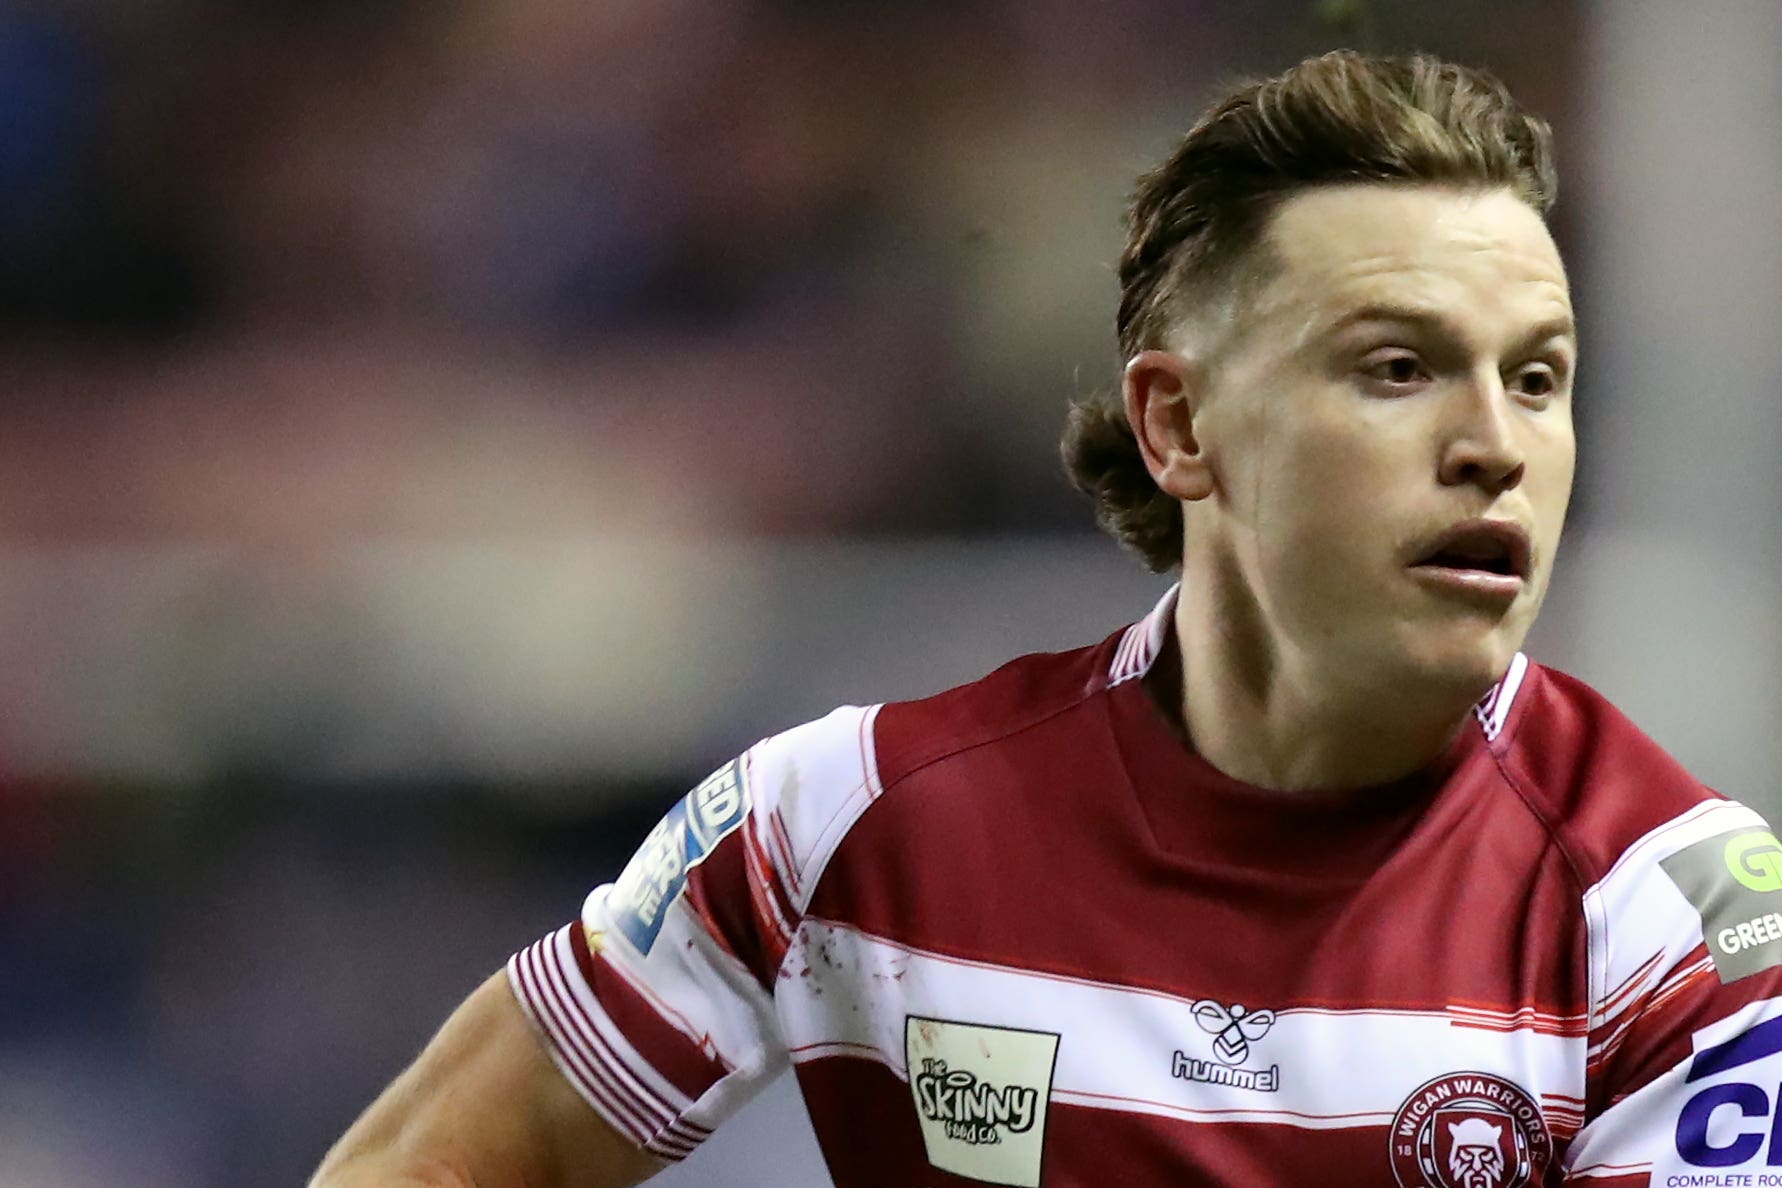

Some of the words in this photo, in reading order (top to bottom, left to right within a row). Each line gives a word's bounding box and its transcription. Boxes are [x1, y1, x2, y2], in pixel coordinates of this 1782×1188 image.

[1172, 1050, 1279, 1092] hummel
[1399, 1083, 1451, 1137] WIGAN
[1454, 1079, 1546, 1143] WARRIORS
[1667, 1175, 1752, 1188] COMPLETE
